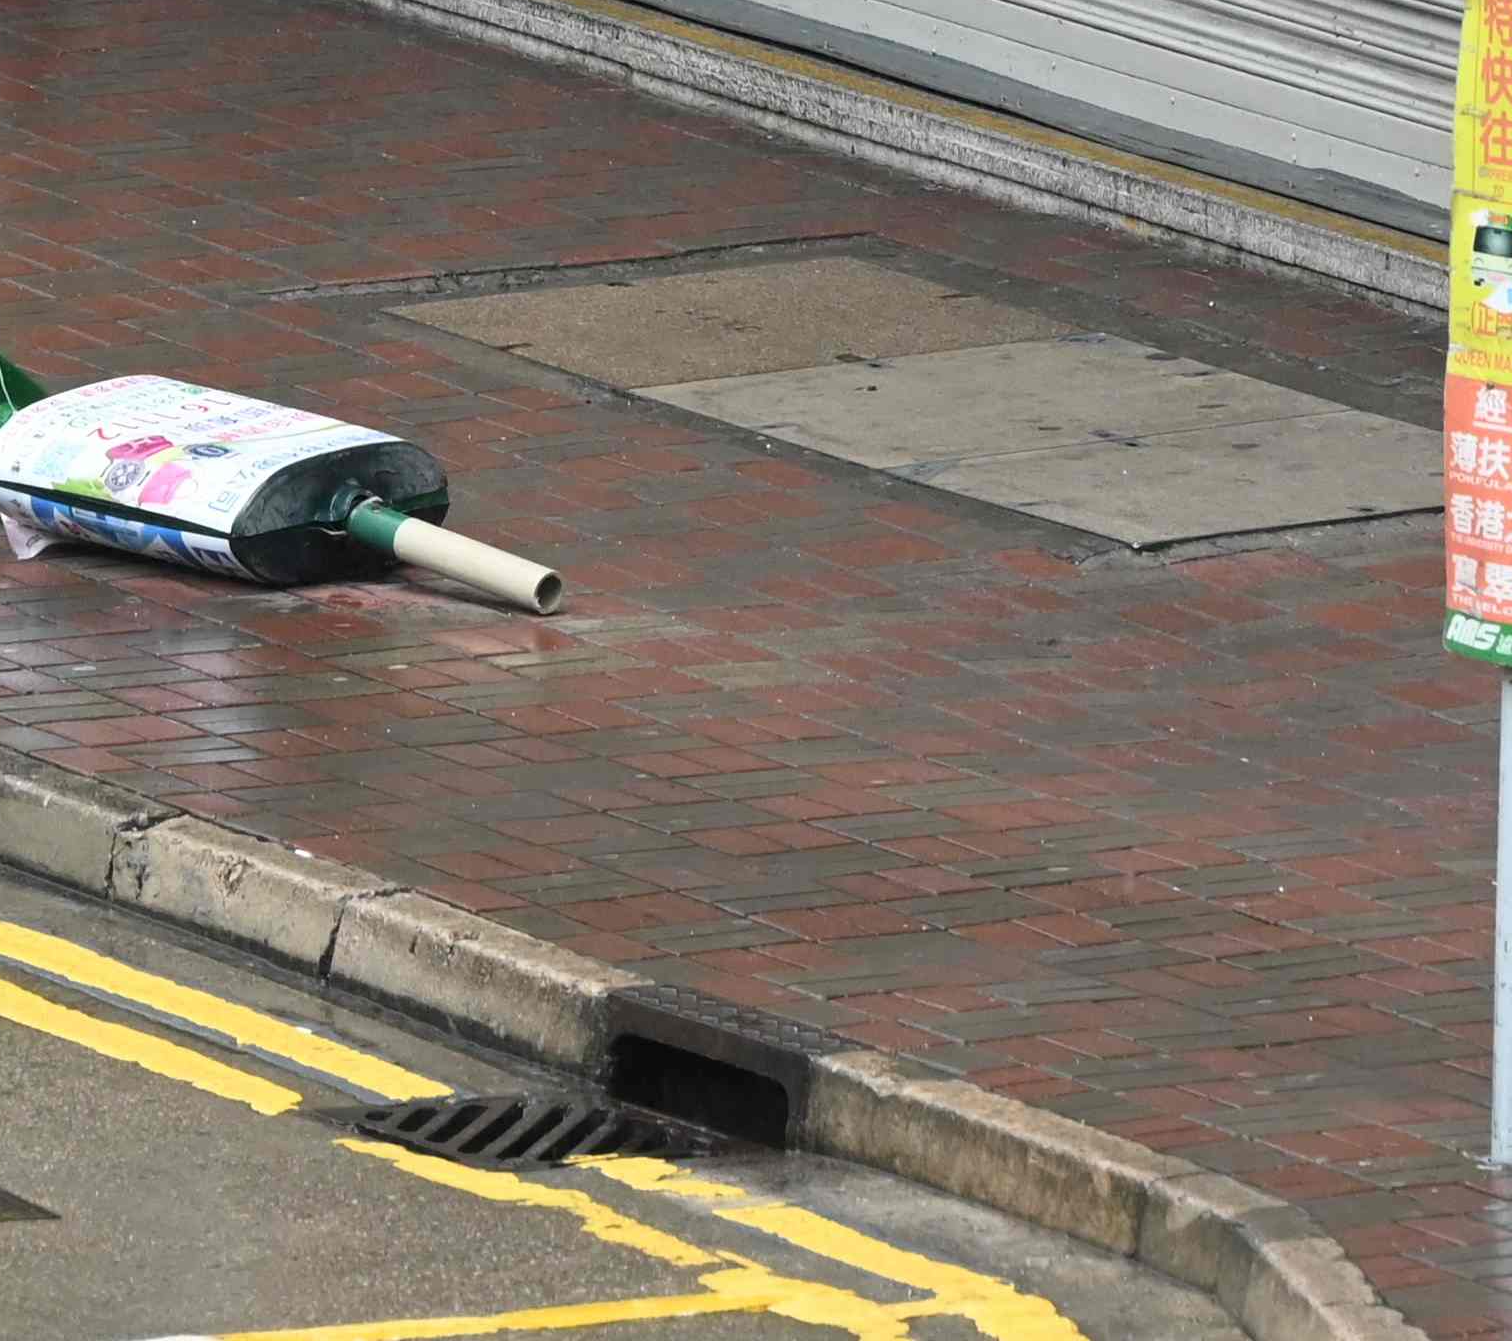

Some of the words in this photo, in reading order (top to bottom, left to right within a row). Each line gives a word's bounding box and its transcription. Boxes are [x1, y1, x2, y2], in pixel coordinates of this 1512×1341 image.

[1454, 348, 1491, 370] QUEEN
[1475, 387, 1509, 425] 經
[1446, 614, 1502, 651] AMS
